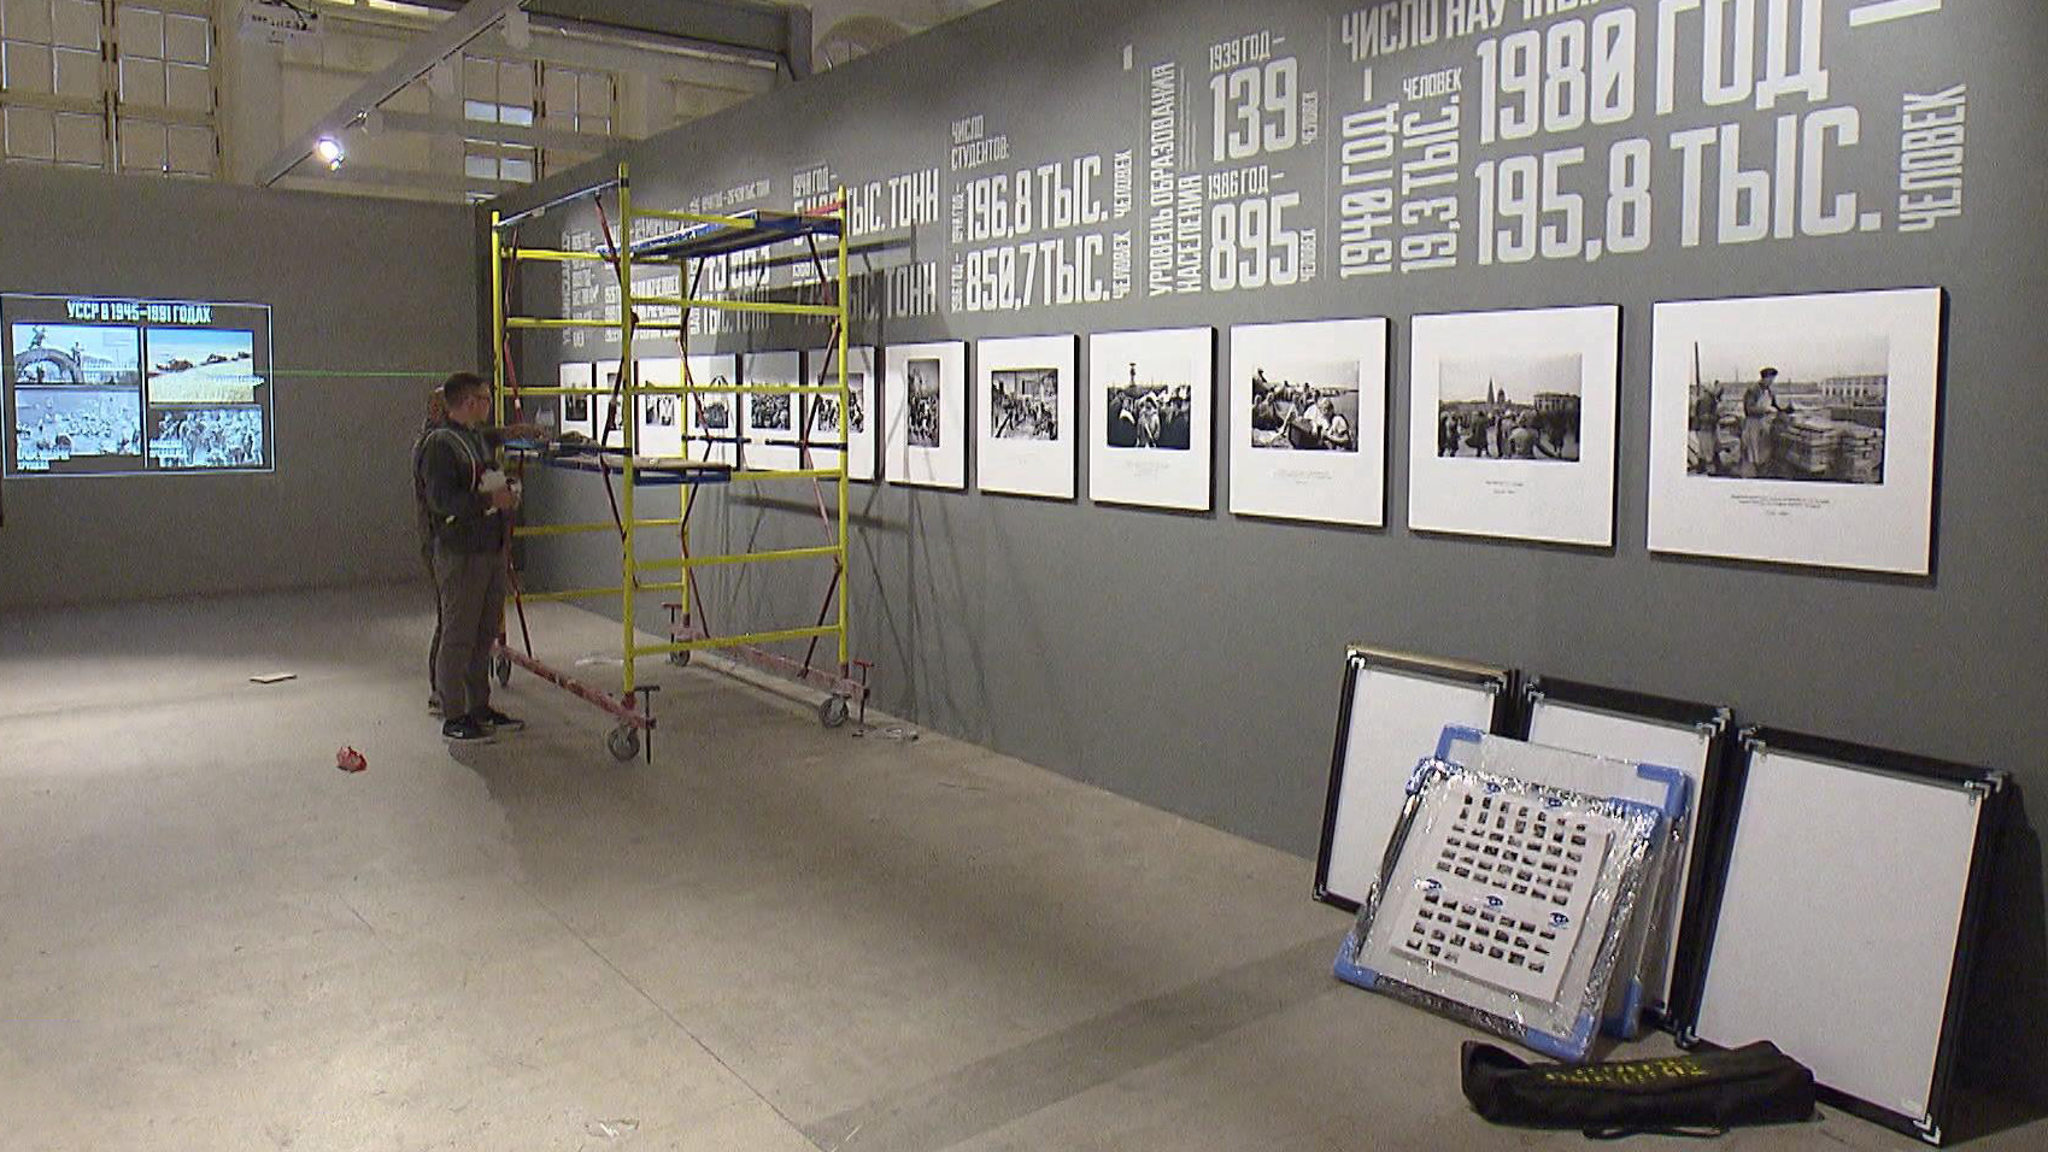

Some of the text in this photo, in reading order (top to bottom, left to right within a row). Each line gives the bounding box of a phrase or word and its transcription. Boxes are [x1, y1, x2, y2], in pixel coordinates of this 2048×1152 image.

[1210, 39, 1240, 72] 1939
[1242, 30, 1270, 63] ГОД
[1342, 0, 1441, 62] ЧИСЛО
[1476, 8, 1636, 144] 1980
[1655, 0, 1829, 115] ГОД
[1210, 56, 1297, 161] 139
[1402, 67, 1462, 101] ЧЕЛОВЕК
[1114, 149, 1132, 218] ЧЕЛОВЕК
[1149, 62, 1175, 297] УРОВЕНЬ ОБРАЗОВАНИЯ
[1208, 170, 1239, 200] 1986
[1241, 165, 1269, 195] ГОД
[1342, 103, 1399, 186] ГОД
[1401, 95, 1460, 274] 19,3 ТЫС.
[1474, 105, 1881, 265] 195,8 ТЫС.
[1899, 83, 1967, 232] ЧЕЛОВЕК
[888, 168, 939, 226] ТОНН
[966, 155, 1108, 242] 196,8 ТЫС.
[1177, 175, 1202, 293] НАСЕЛЕНИЯ
[1341, 187, 1393, 280] 1940
[966, 233, 1110, 312] 850,7 ТЫС.
[1112, 230, 1131, 299] ЧЕЛОВЕК
[1210, 192, 1299, 292] 895
[67, 300, 99, 318] УССР
[173, 304, 212, 323] ГОДАХ
[884, 261, 937, 319] ТОНН
